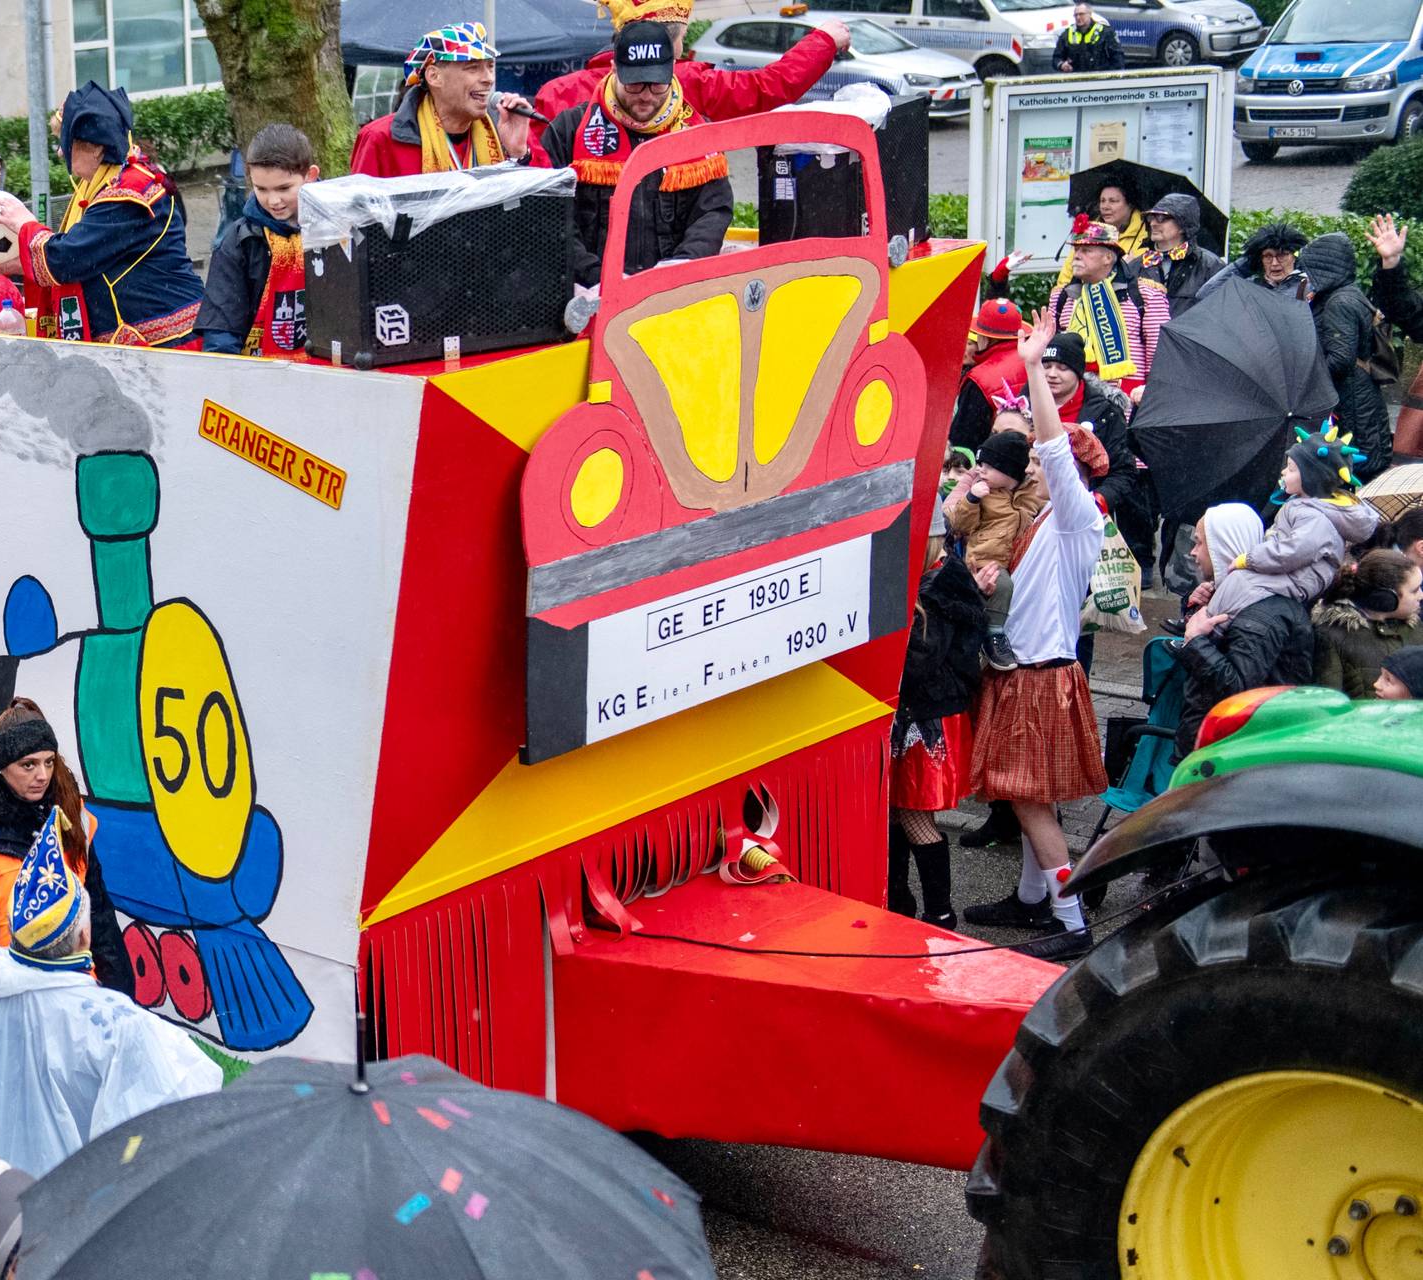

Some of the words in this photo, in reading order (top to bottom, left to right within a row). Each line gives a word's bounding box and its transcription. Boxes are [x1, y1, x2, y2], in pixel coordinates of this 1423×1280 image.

[628, 44, 662, 60] SWAT
[1267, 63, 1339, 74] POLIZEI
[1019, 97, 1068, 107] Katholische
[1072, 91, 1145, 104] Kirchengemeinde
[1148, 90, 1161, 98] St.
[1164, 88, 1197, 98] Barbara
[1089, 283, 1122, 363] arrenzunft
[203, 406, 296, 479] CRANGER
[299, 457, 342, 503] STR
[658, 612, 684, 640] GE
[703, 599, 726, 627] EF
[749, 578, 790, 610] 1930
[799, 572, 810, 595] E
[598, 694, 625, 723] KG
[637, 682, 690, 710] Erler
[704, 655, 770, 686] Funken
[786, 622, 827, 655] 1930
[153, 687, 237, 798] 50
